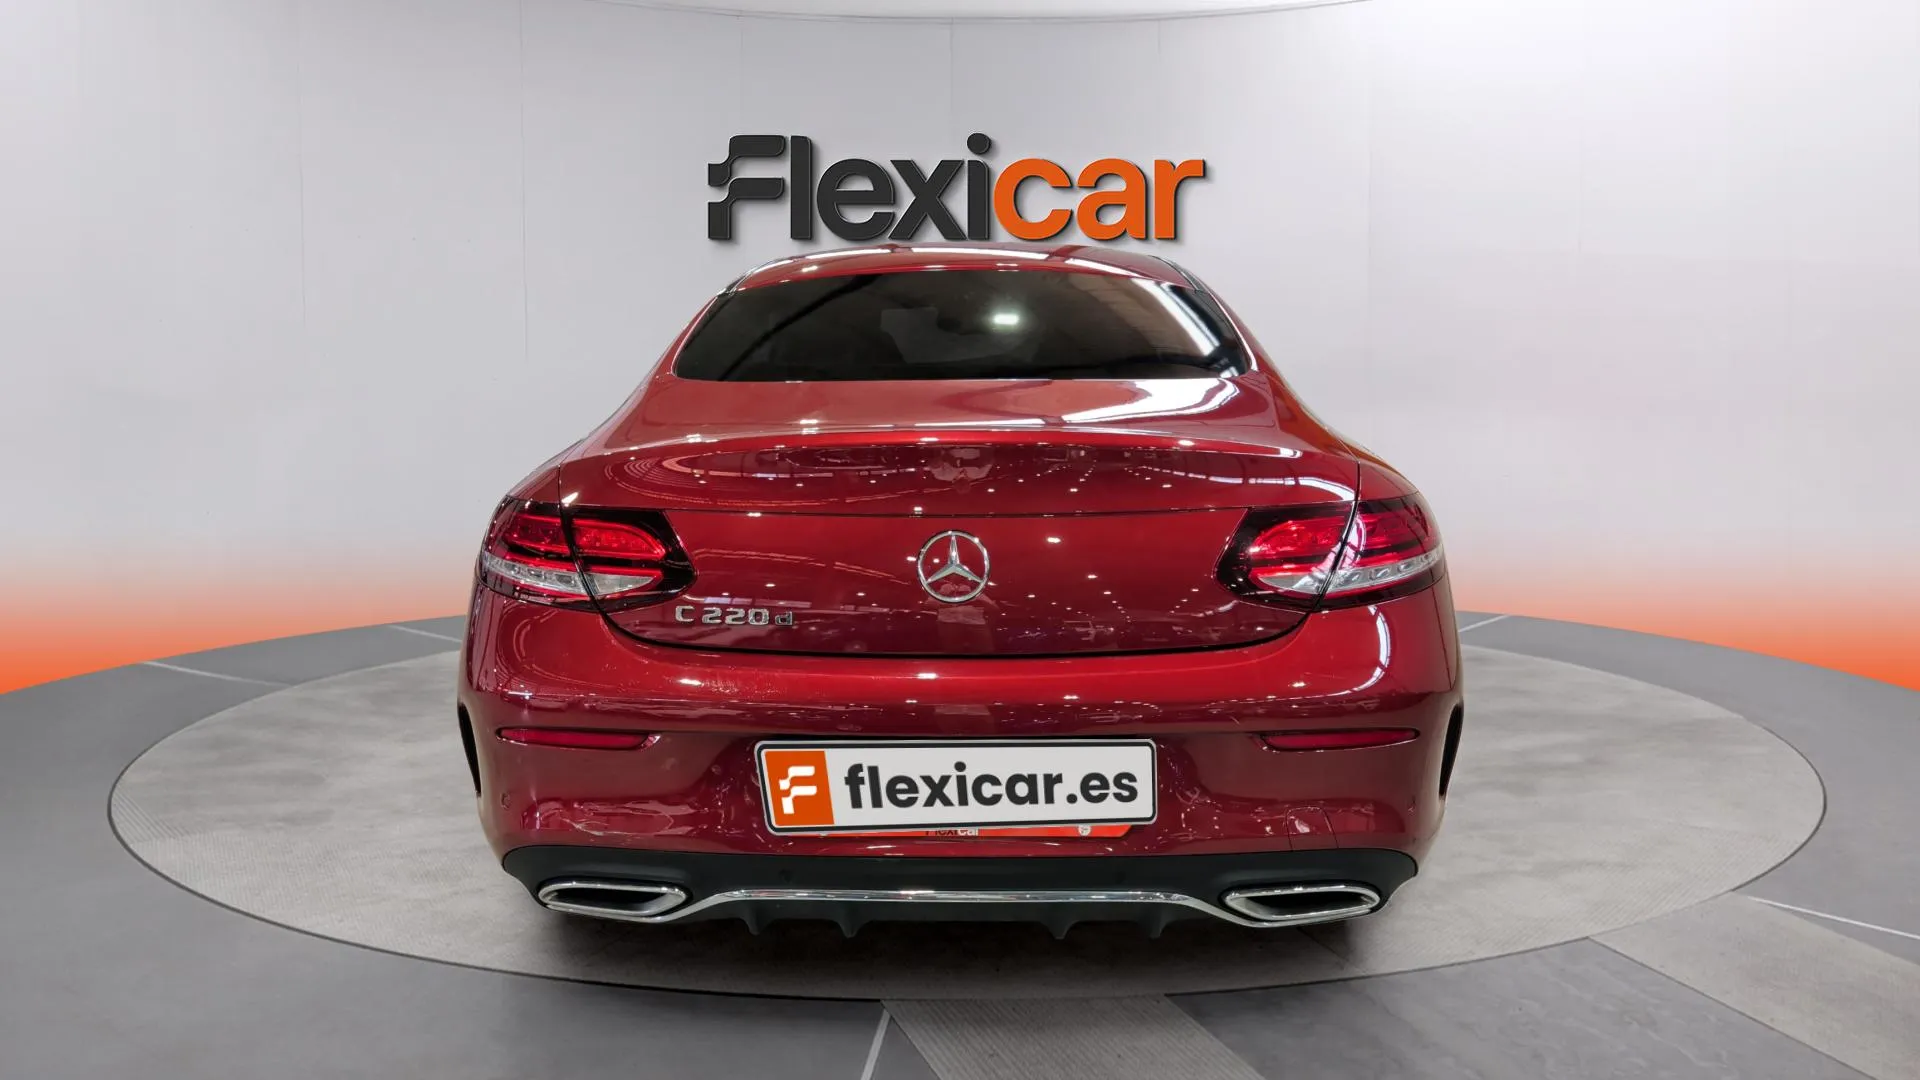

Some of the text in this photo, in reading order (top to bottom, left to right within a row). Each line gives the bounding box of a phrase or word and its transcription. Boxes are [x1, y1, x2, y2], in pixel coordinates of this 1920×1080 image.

[708, 133, 1205, 241] Flexicar
[675, 605, 793, 626] C 220 d
[844, 761, 1139, 810] flexicar.es
